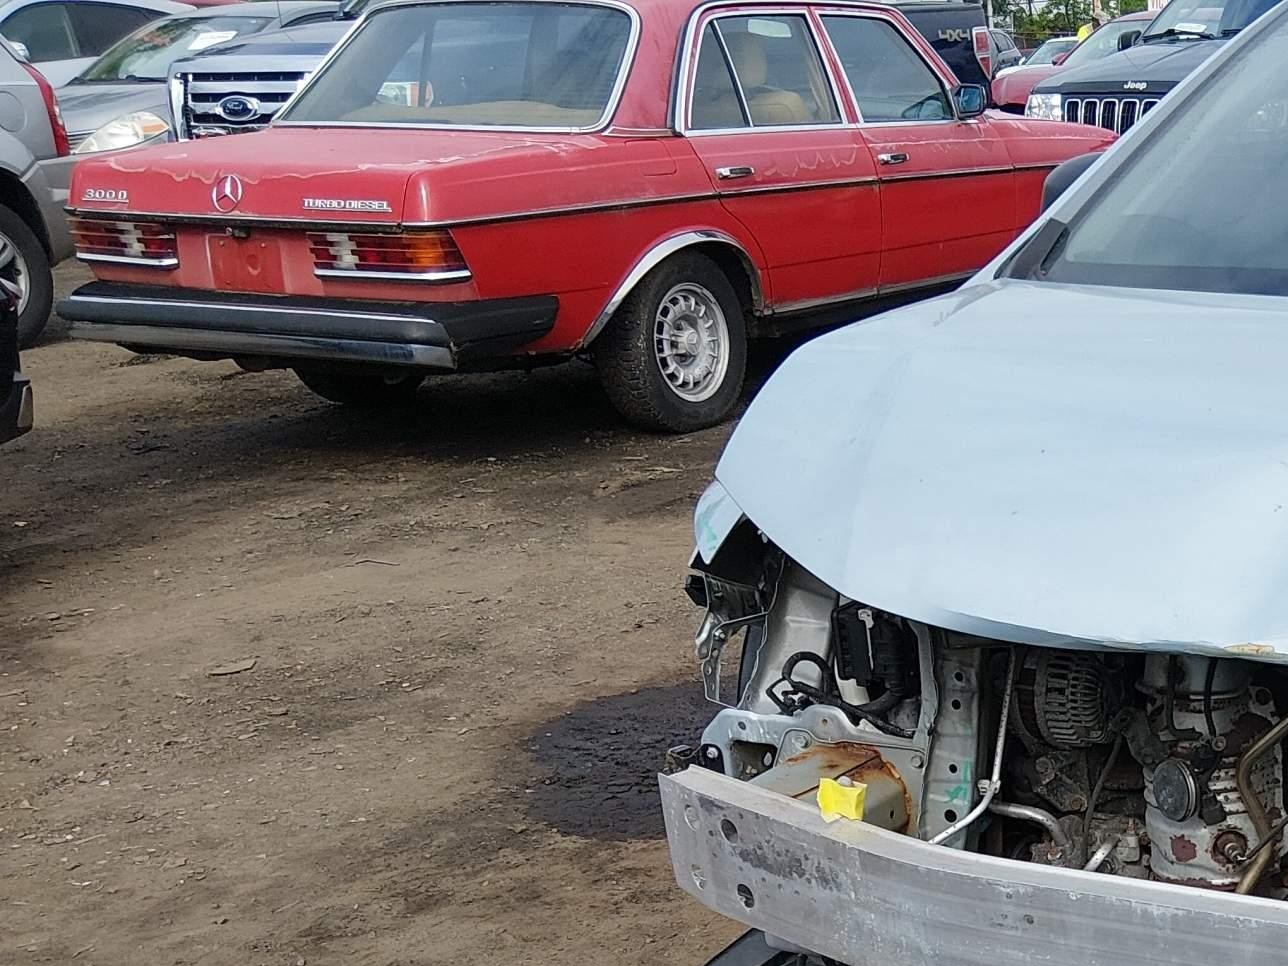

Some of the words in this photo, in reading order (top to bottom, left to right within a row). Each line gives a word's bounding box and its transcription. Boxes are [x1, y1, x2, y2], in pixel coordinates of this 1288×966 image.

[1123, 80, 1148, 90] Jeep
[302, 198, 344, 209] TURBO
[345, 200, 389, 210] DIESEL
